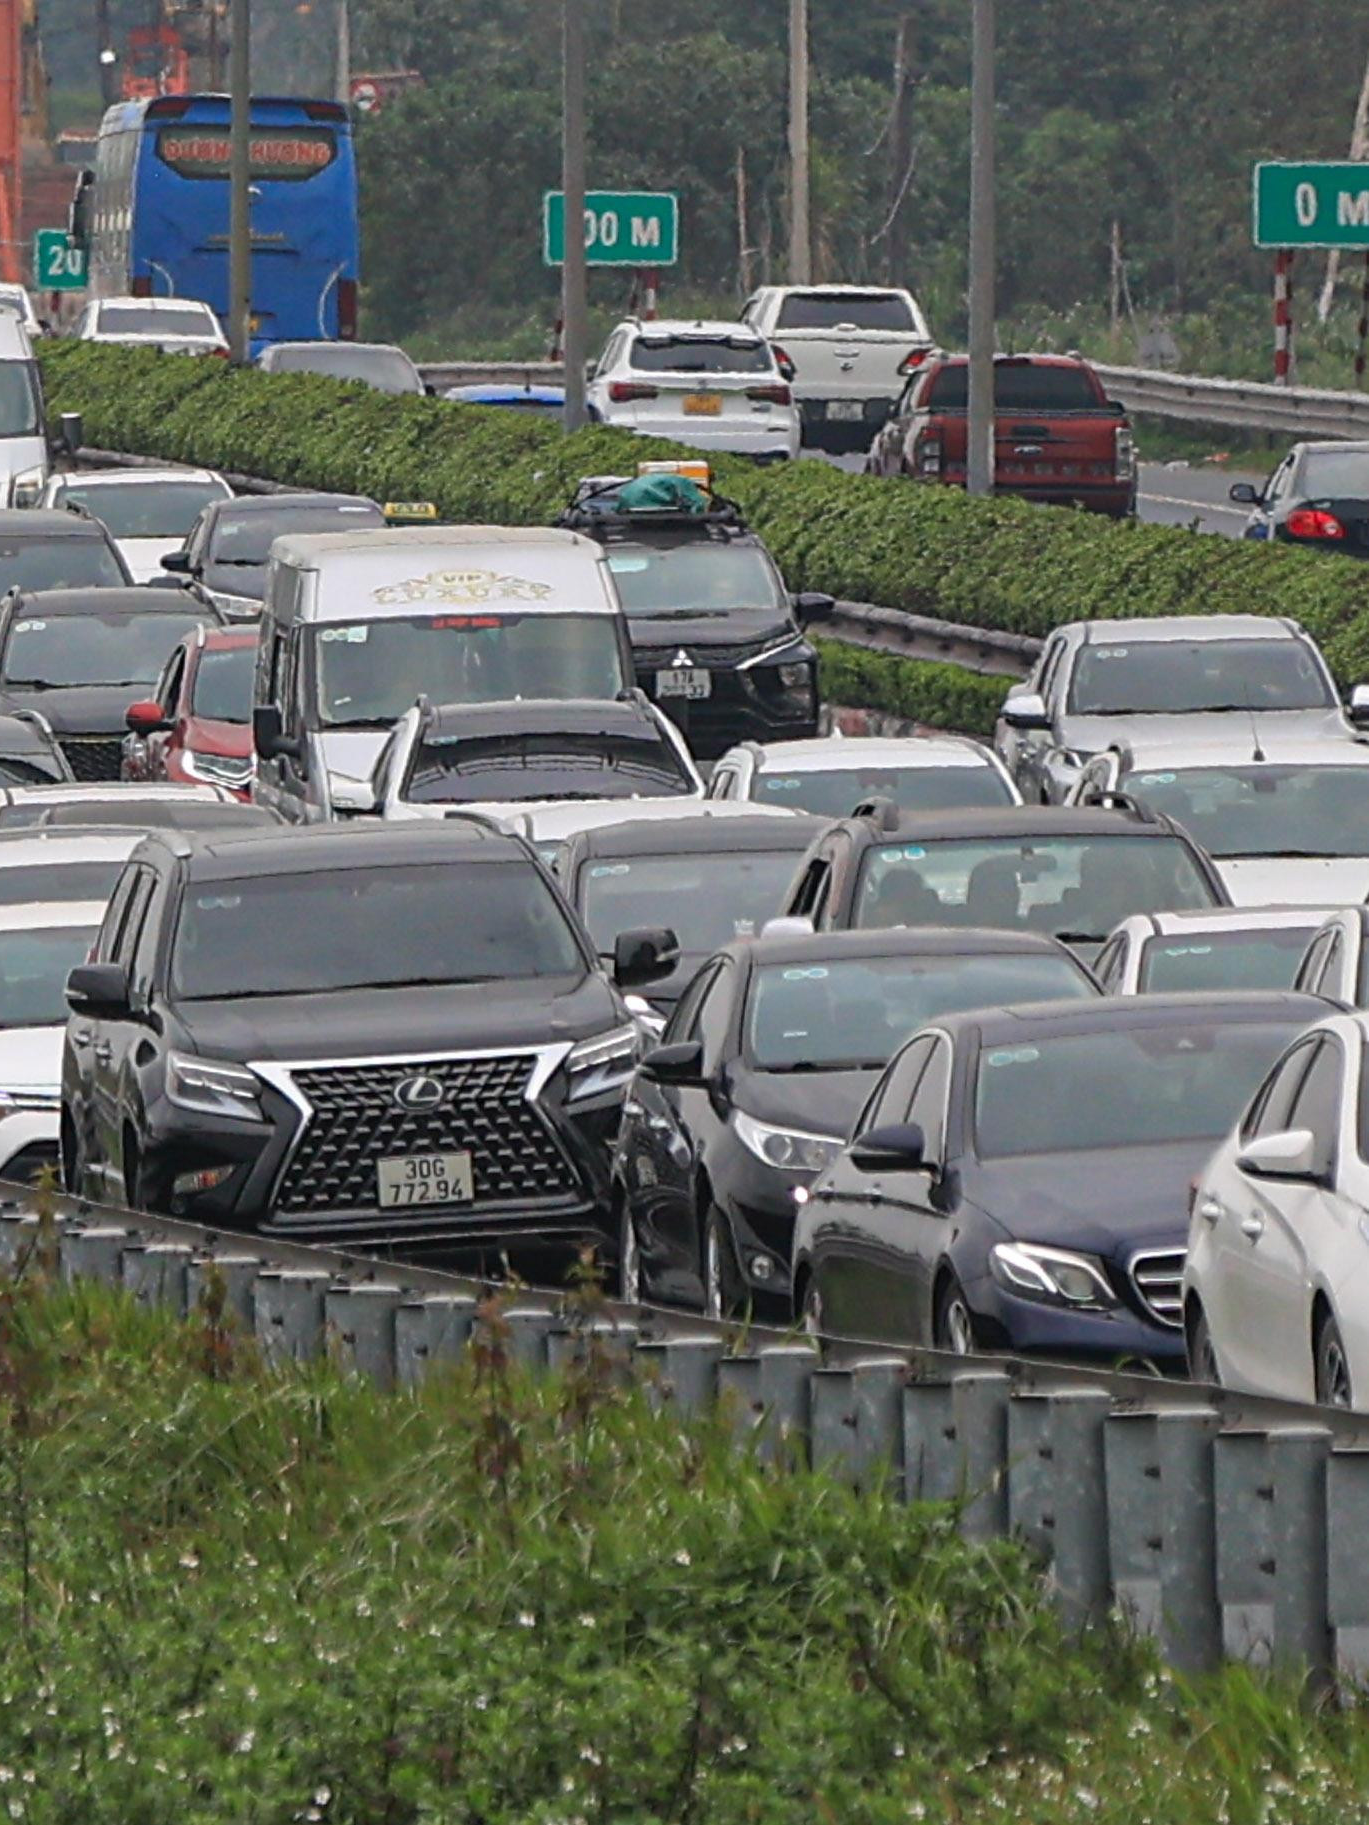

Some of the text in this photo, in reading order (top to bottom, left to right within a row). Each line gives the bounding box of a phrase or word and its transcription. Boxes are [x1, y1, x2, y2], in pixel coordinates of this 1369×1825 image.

[1295, 182, 1369, 227] 0 M
[631, 215, 661, 247] M
[405, 1159, 446, 1180] 30G
[389, 1178, 464, 1203] 772.94
